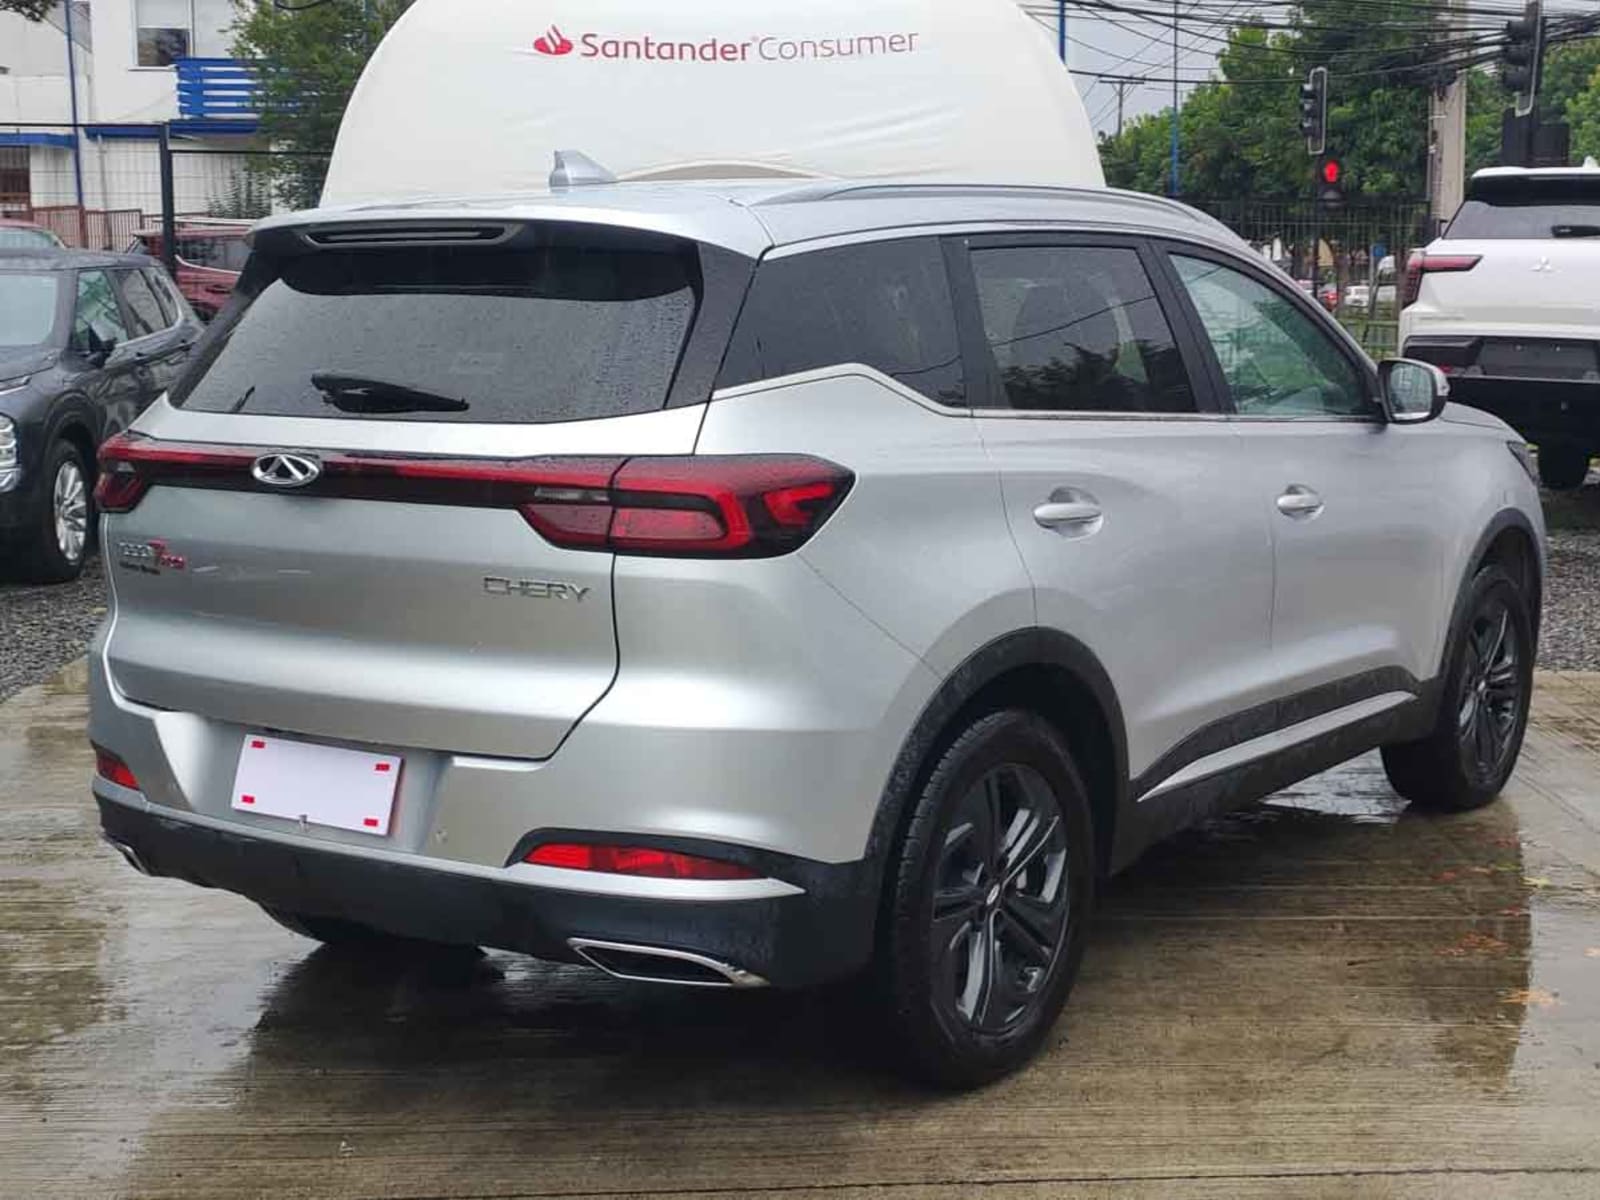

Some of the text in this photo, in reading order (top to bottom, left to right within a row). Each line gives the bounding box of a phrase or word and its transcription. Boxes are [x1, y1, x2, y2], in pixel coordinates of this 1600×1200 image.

[580, 32, 919, 62] Santander Consumer
[483, 576, 591, 603] CHERY
